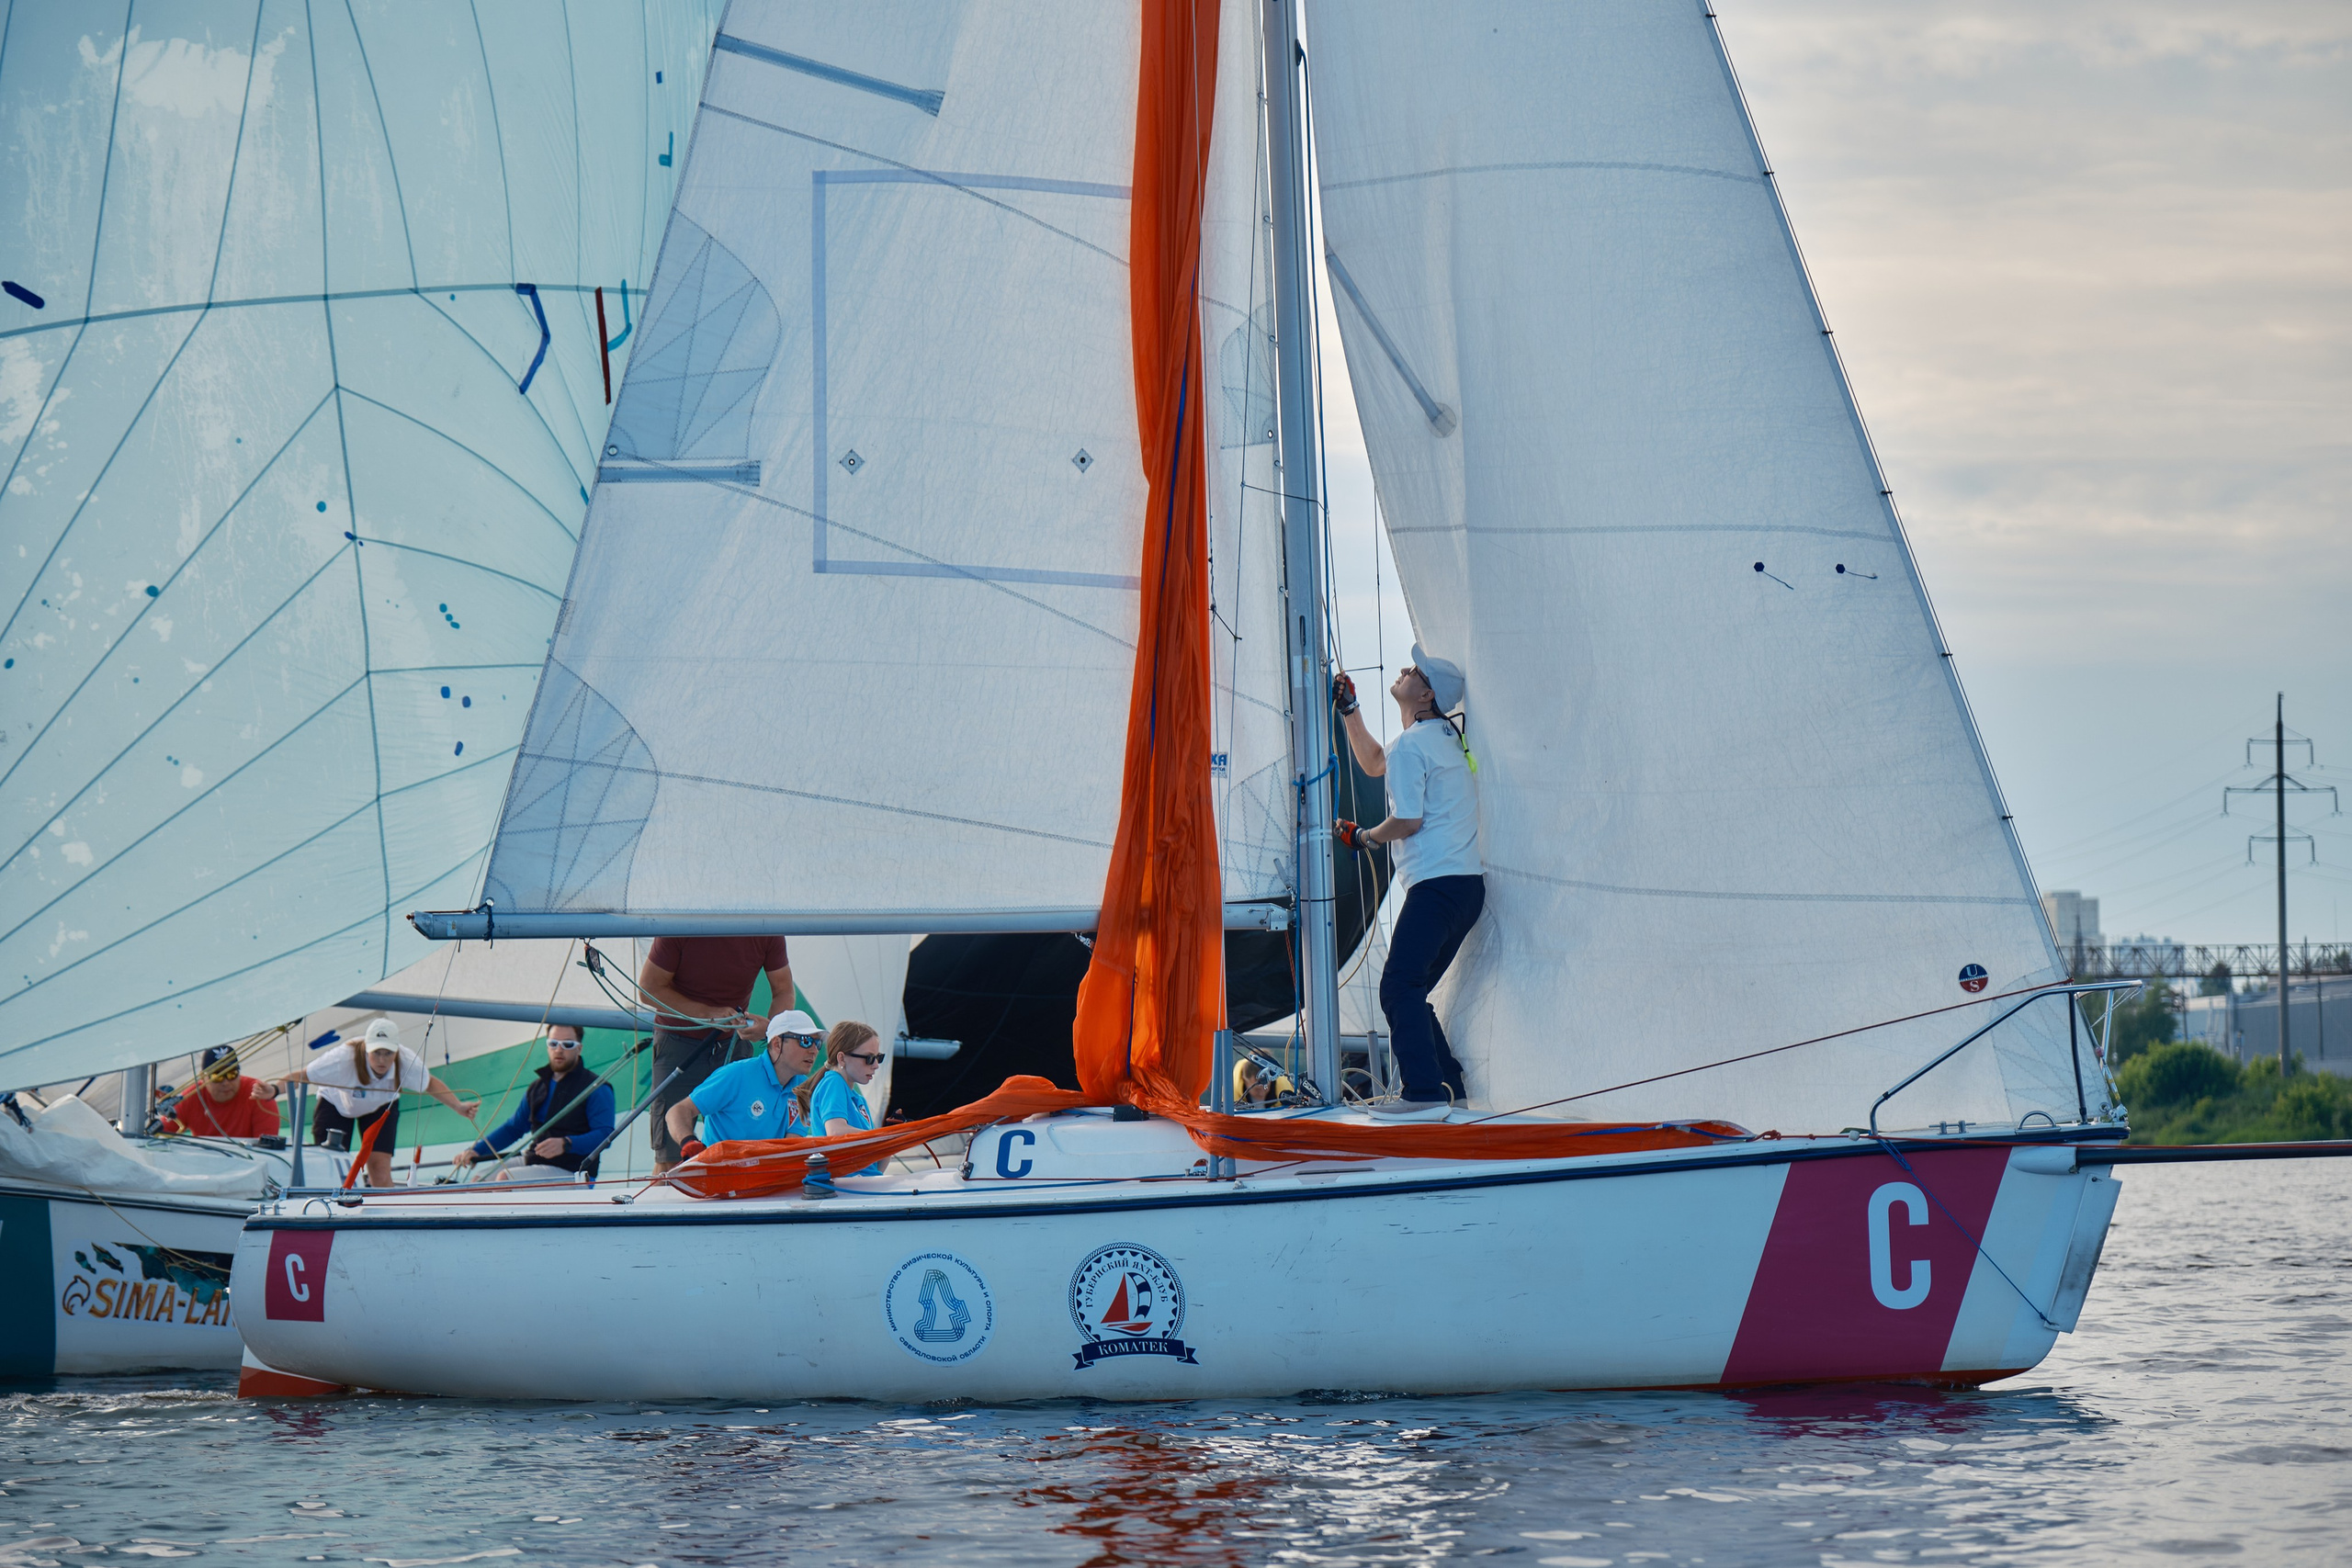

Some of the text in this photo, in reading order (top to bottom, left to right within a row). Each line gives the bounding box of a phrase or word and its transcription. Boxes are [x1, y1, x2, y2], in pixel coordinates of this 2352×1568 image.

[996, 1129, 1035, 1179] C
[1868, 1181, 1931, 1310] C
[89, 1278, 236, 1326] SIMA-LA
[285, 1253, 310, 1303] C
[885, 1269, 902, 1332] МИНИСТЕРСТВО
[901, 1253, 954, 1270] ФИЗИЧЕСКОЙ
[955, 1258, 987, 1291] КУЛЬТУРЫ
[984, 1300, 992, 1331] СПОРТА
[1086, 1258, 1168, 1308] ГУБЕРНСКИЙ ЯХТ-КЛУБ
[899, 1335, 987, 1362] СВЕРДЛОВСКОЙ ОБЛАСТИ
[1098, 1341, 1168, 1356] КОМАТЕК
